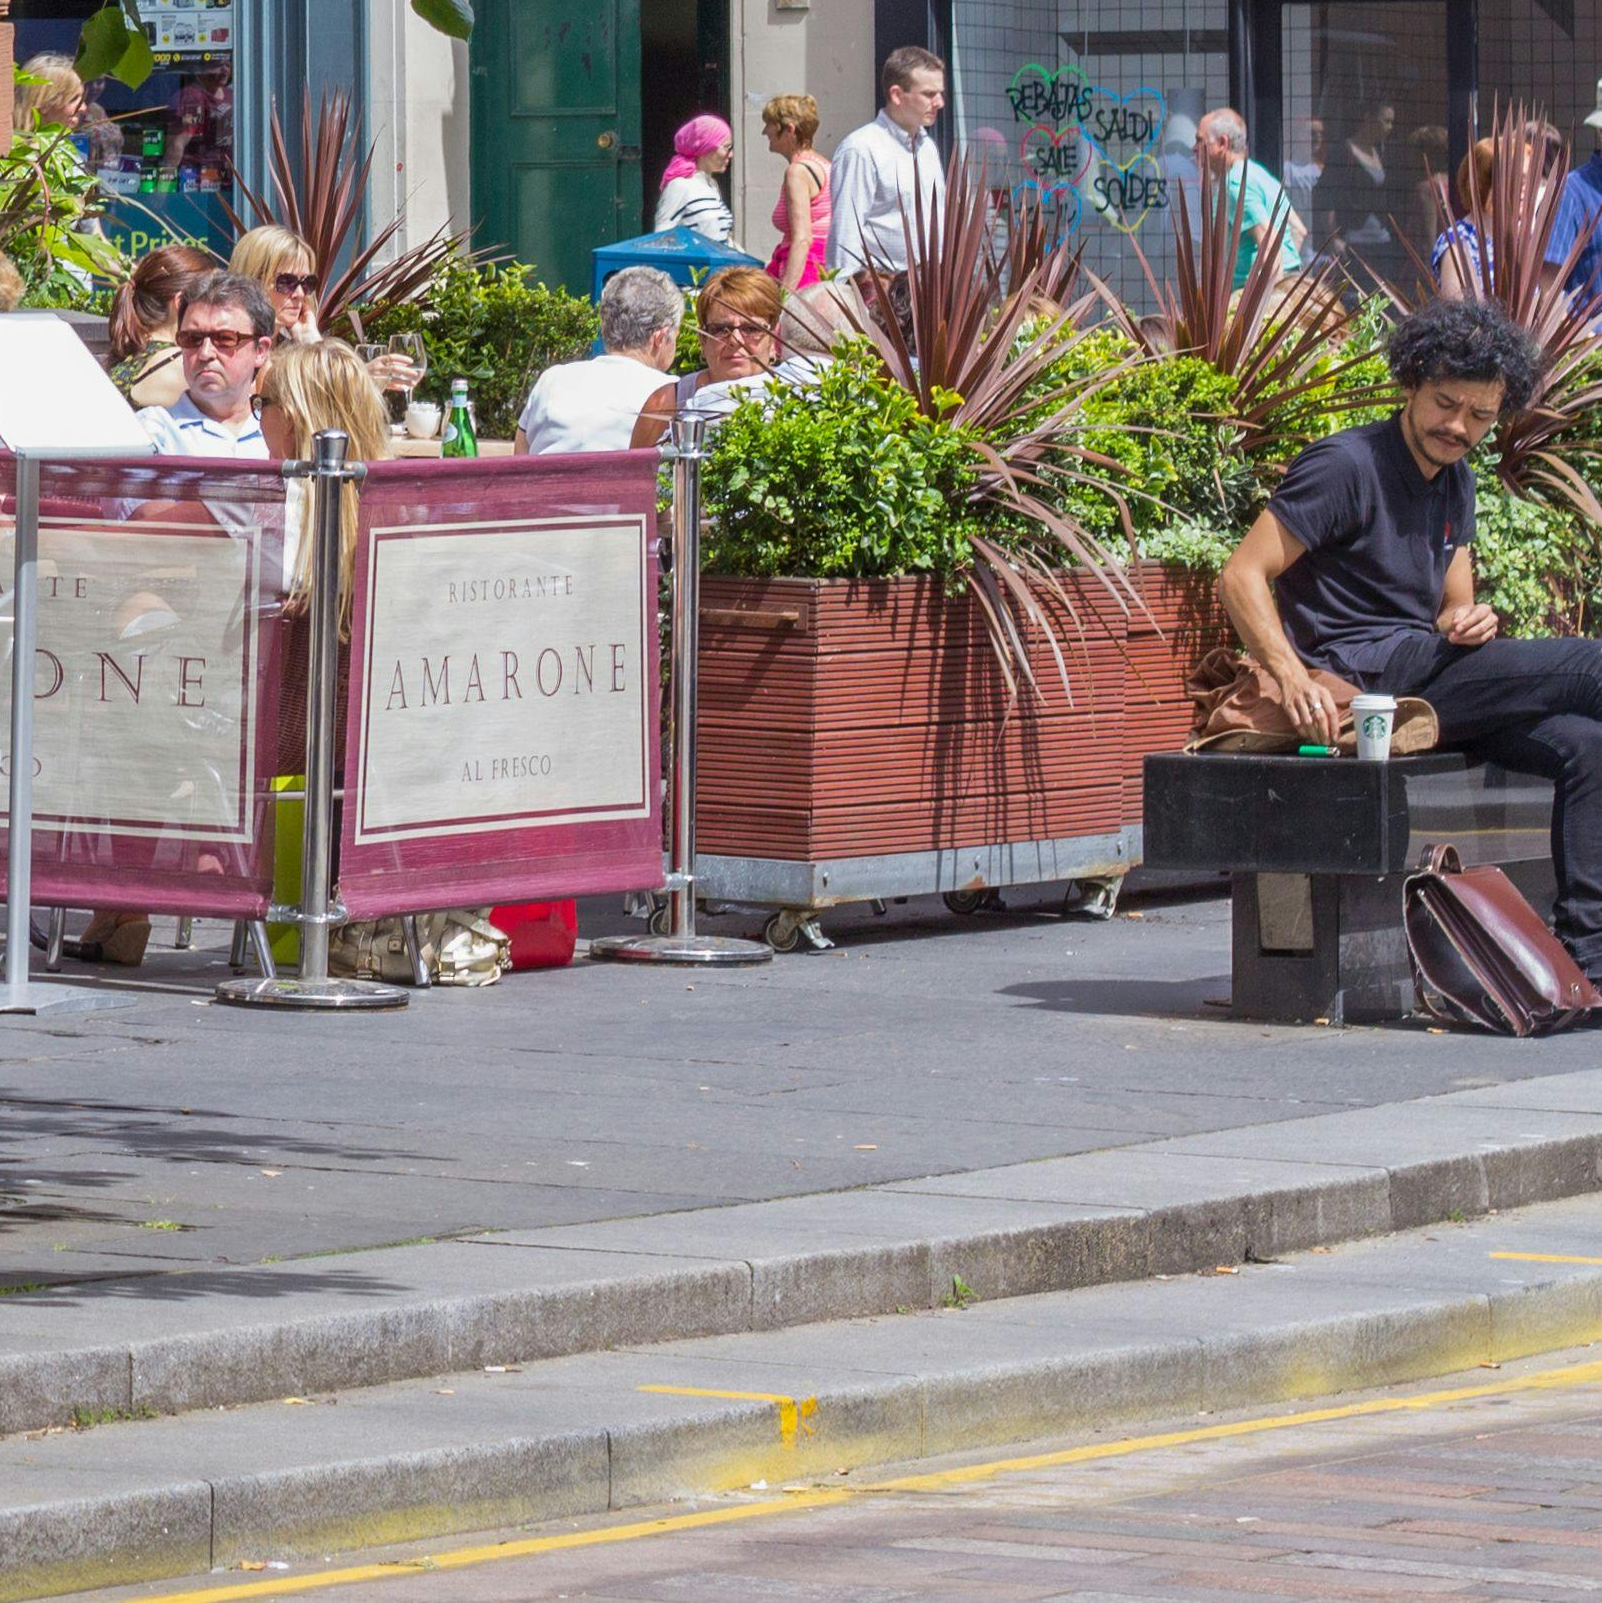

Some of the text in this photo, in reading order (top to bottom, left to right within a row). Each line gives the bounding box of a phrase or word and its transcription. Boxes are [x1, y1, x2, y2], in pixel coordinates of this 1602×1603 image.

[1005, 80, 1093, 123] REBAJAS
[1094, 108, 1154, 143] SALDI
[1034, 145, 1078, 177] SALE
[1094, 169, 1169, 213] SOLDES
[448, 574, 574, 604] RISTORANTE
[385, 643, 628, 711] AMARONE
[461, 754, 552, 782] AL FRESCO
